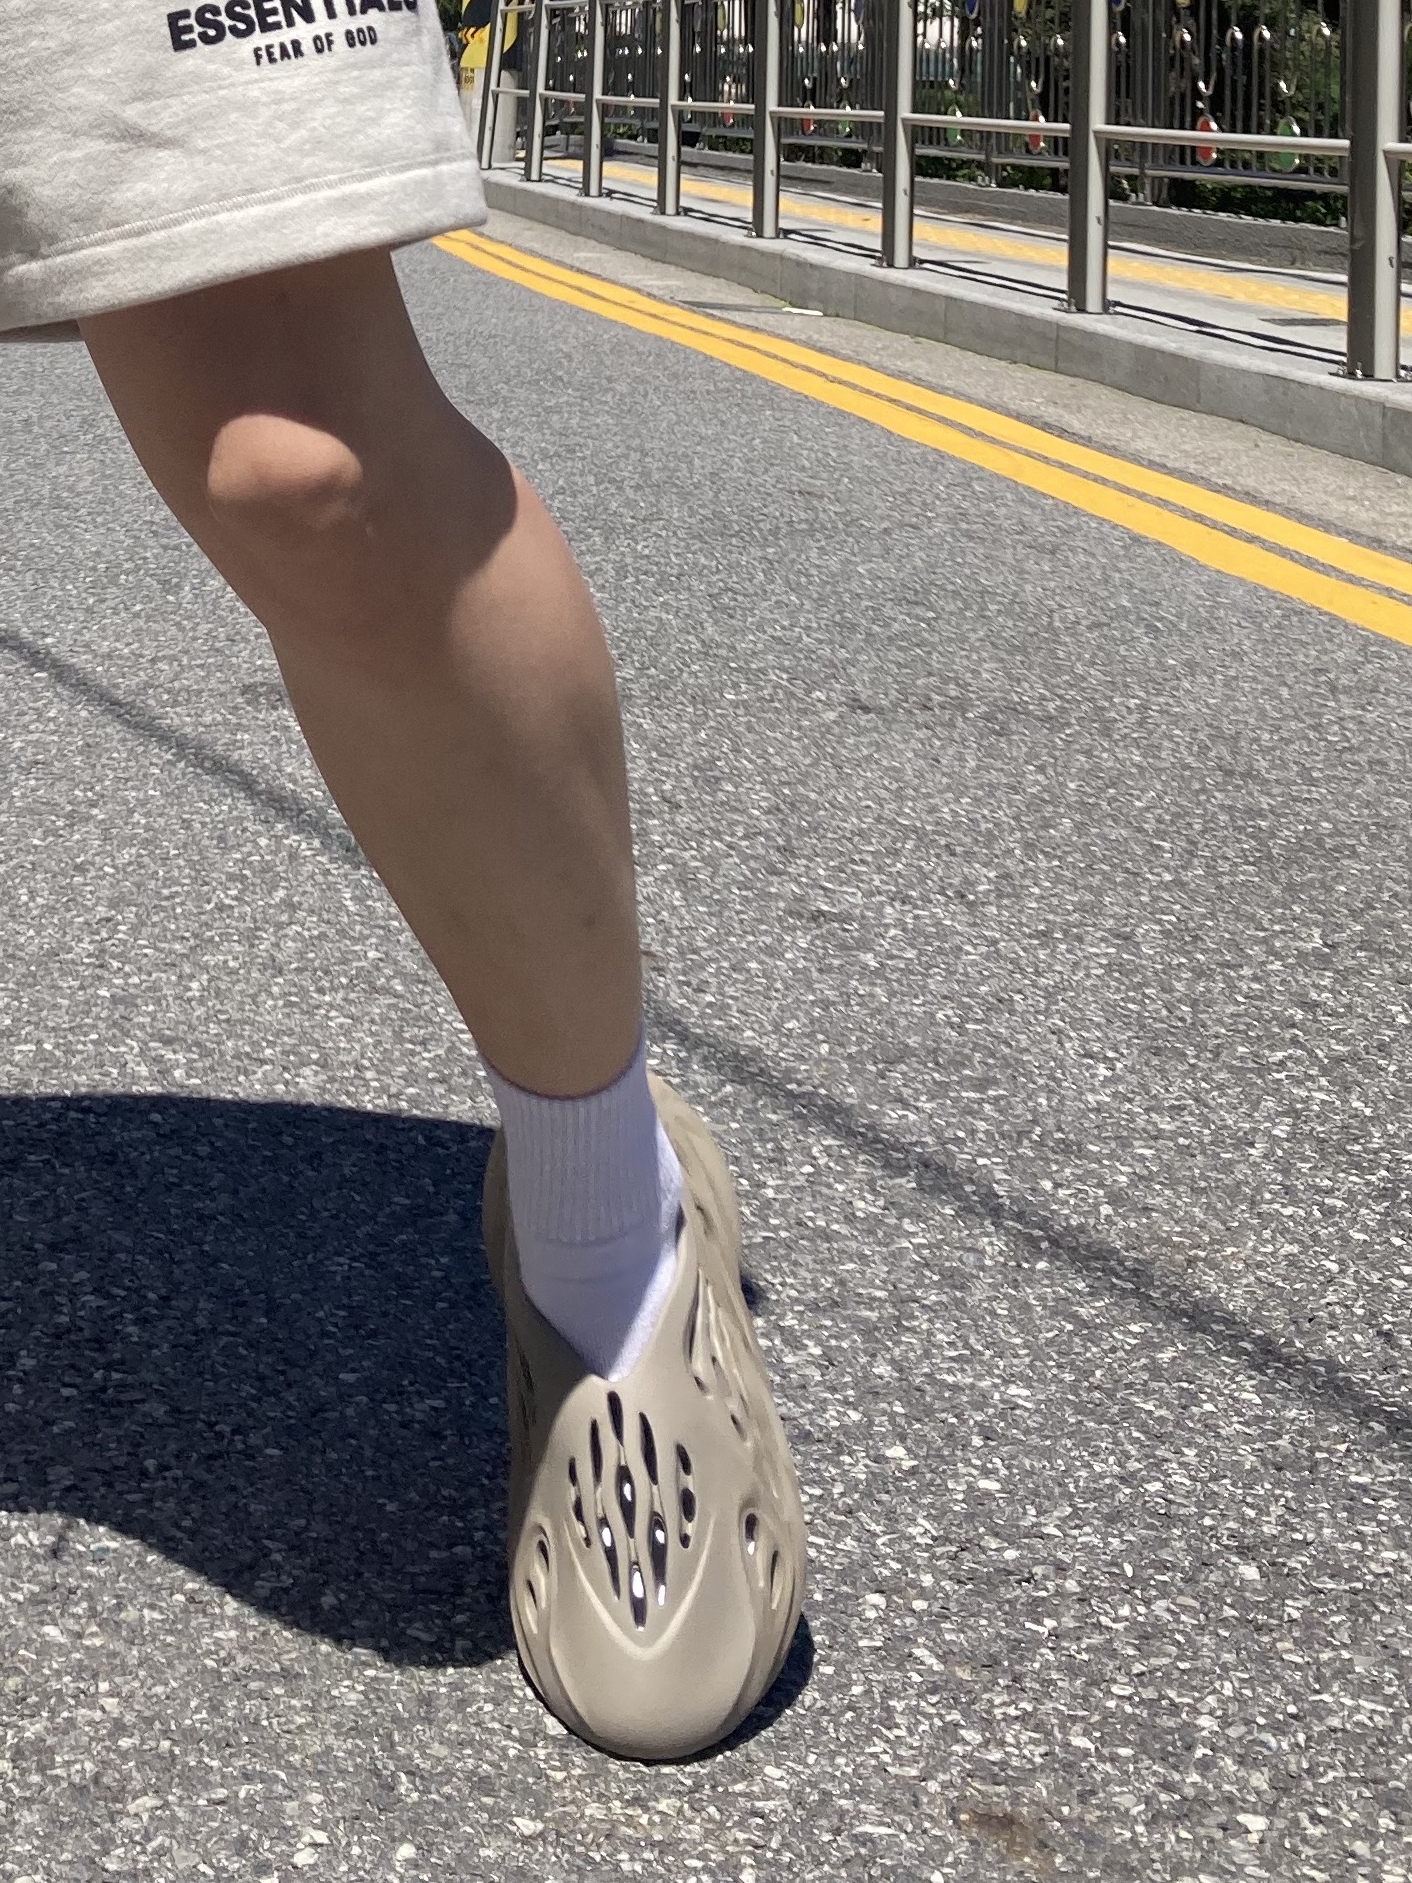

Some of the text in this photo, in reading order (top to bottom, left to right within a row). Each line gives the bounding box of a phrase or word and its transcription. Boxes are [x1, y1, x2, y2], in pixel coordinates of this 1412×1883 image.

[253, 25, 378, 67] FEAR OF GOD
